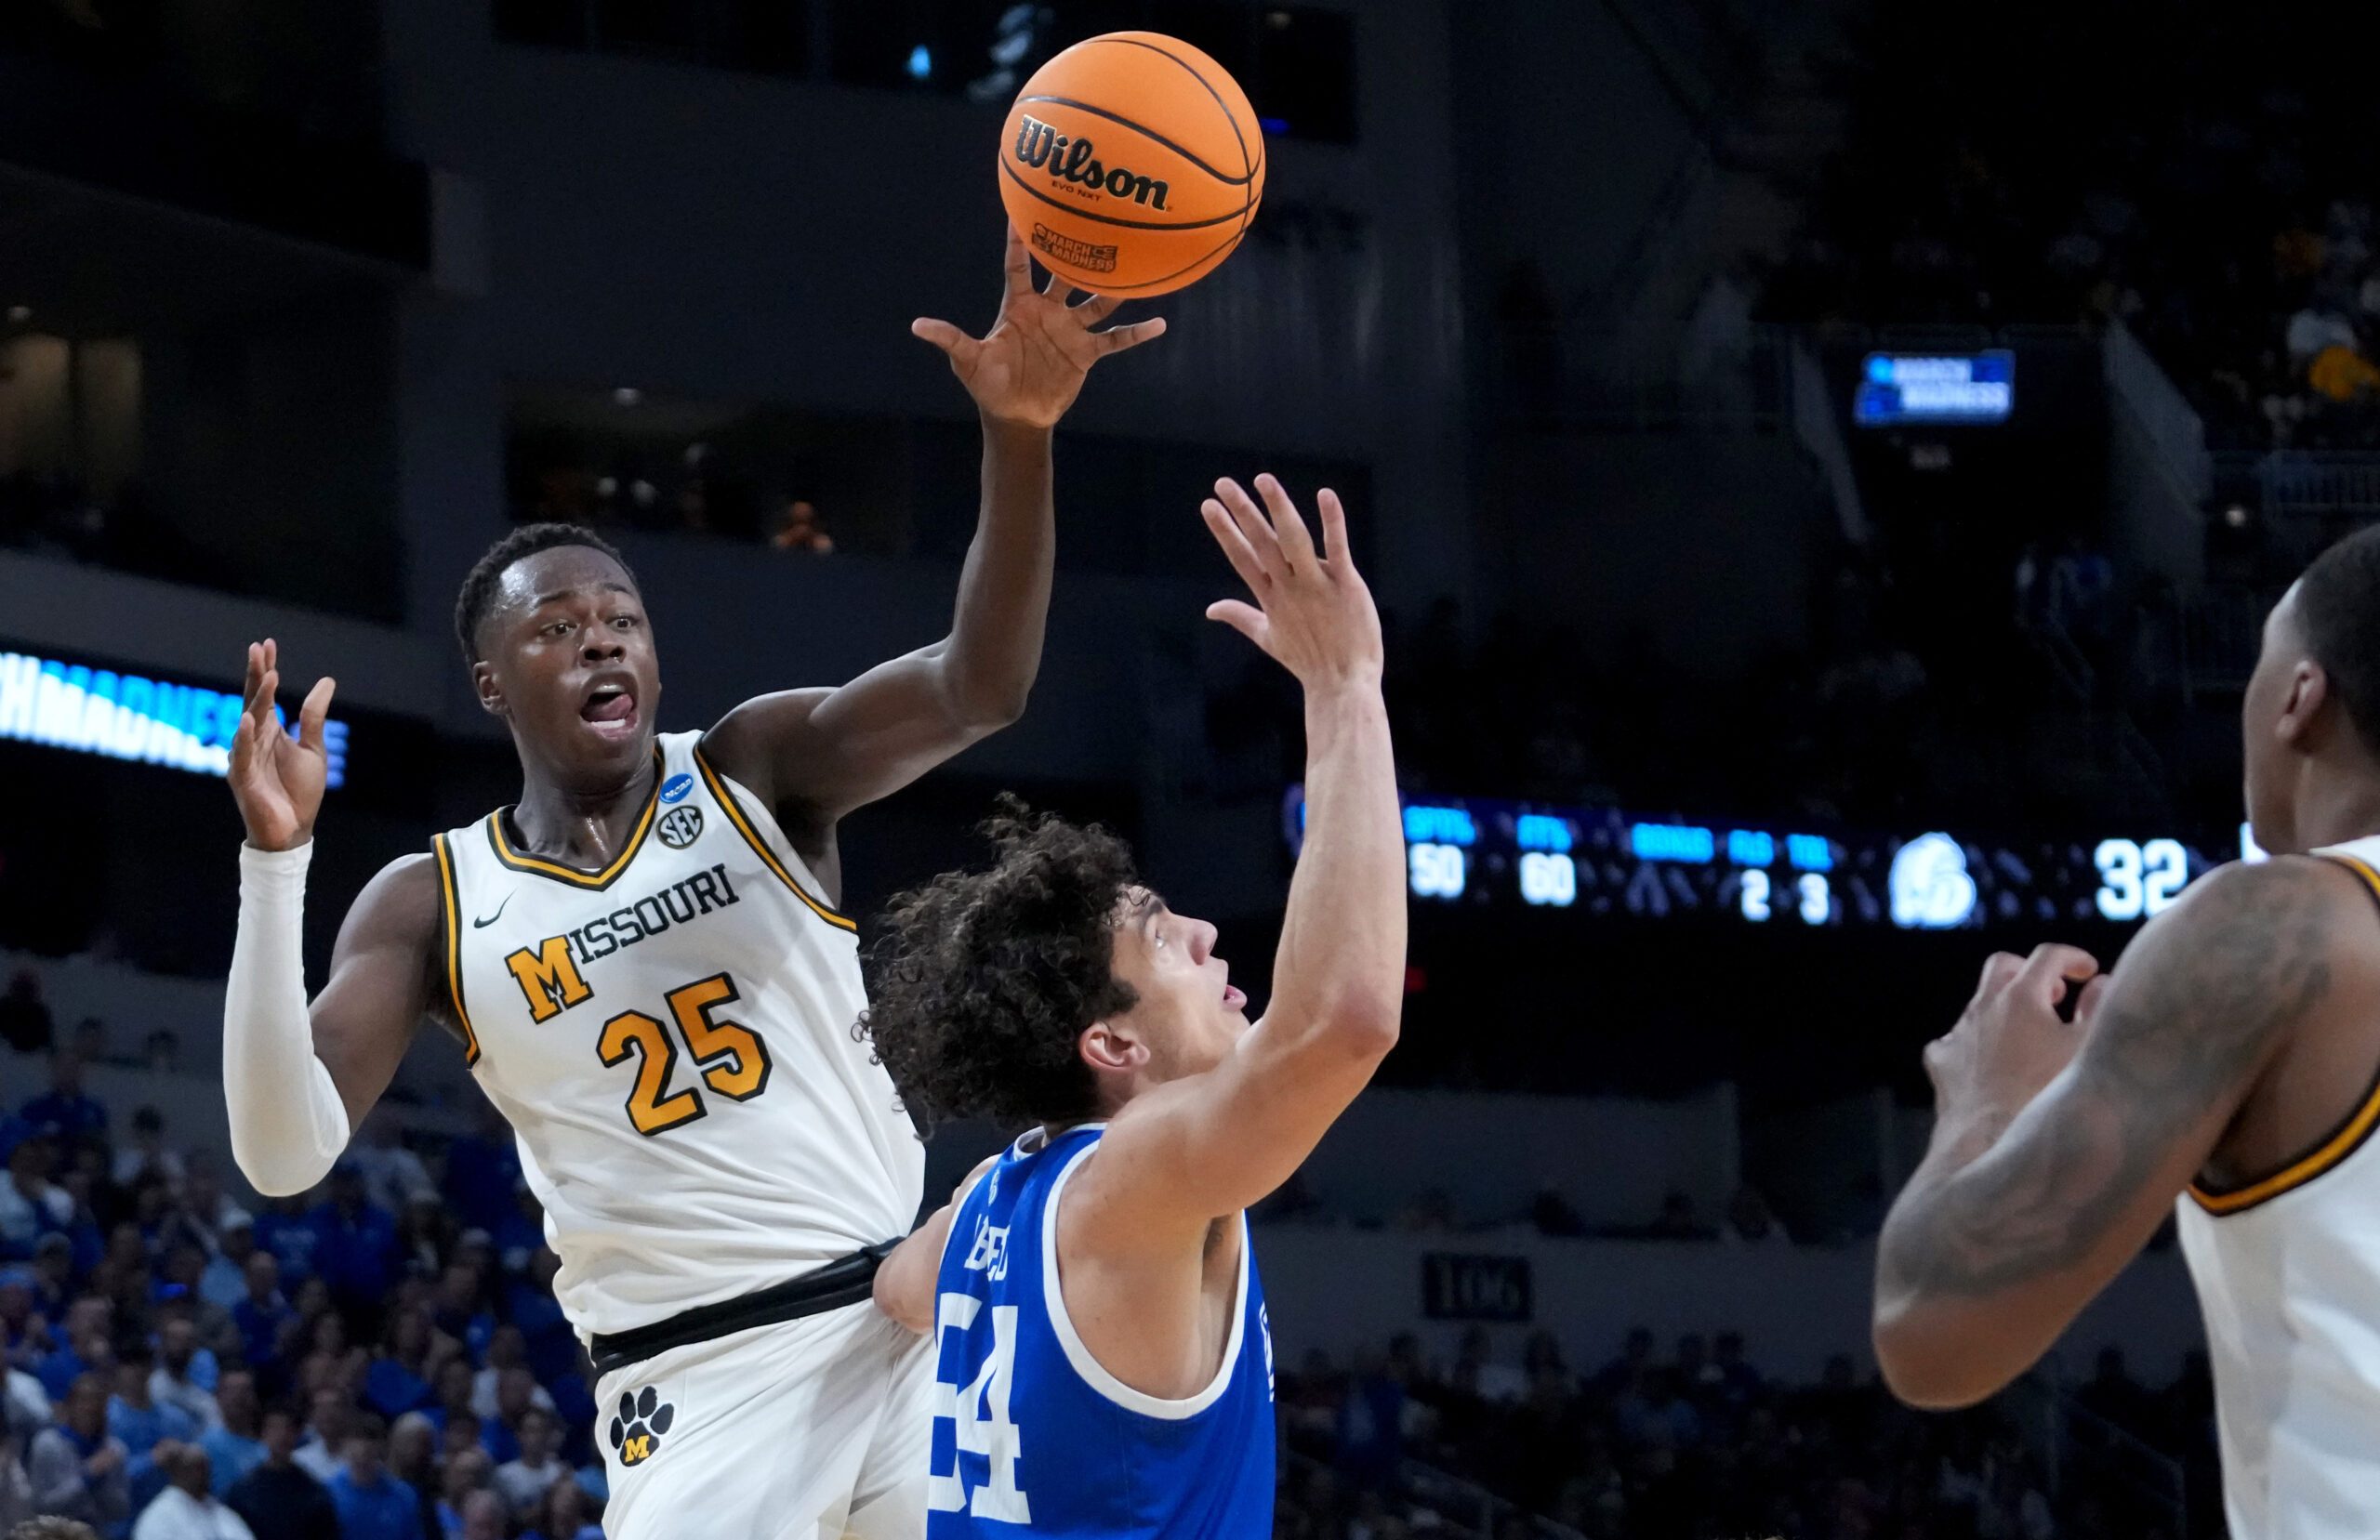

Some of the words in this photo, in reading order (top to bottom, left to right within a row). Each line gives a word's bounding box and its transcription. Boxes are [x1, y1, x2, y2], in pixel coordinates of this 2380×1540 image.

[1015, 113, 1170, 212] Wilson
[1051, 180, 1075, 193] EVO
[1077, 189, 1103, 203] NXT
[1047, 230, 1091, 257] MARCH
[1051, 245, 1115, 271] MADNESS
[659, 807, 701, 846] SEC
[1519, 851, 1577, 907] 60
[1740, 868, 1771, 923] 2
[2094, 838, 2188, 921] 32
[504, 863, 741, 1025] MISSOURI
[596, 971, 773, 1138] 25
[625, 1435, 650, 1463] M
